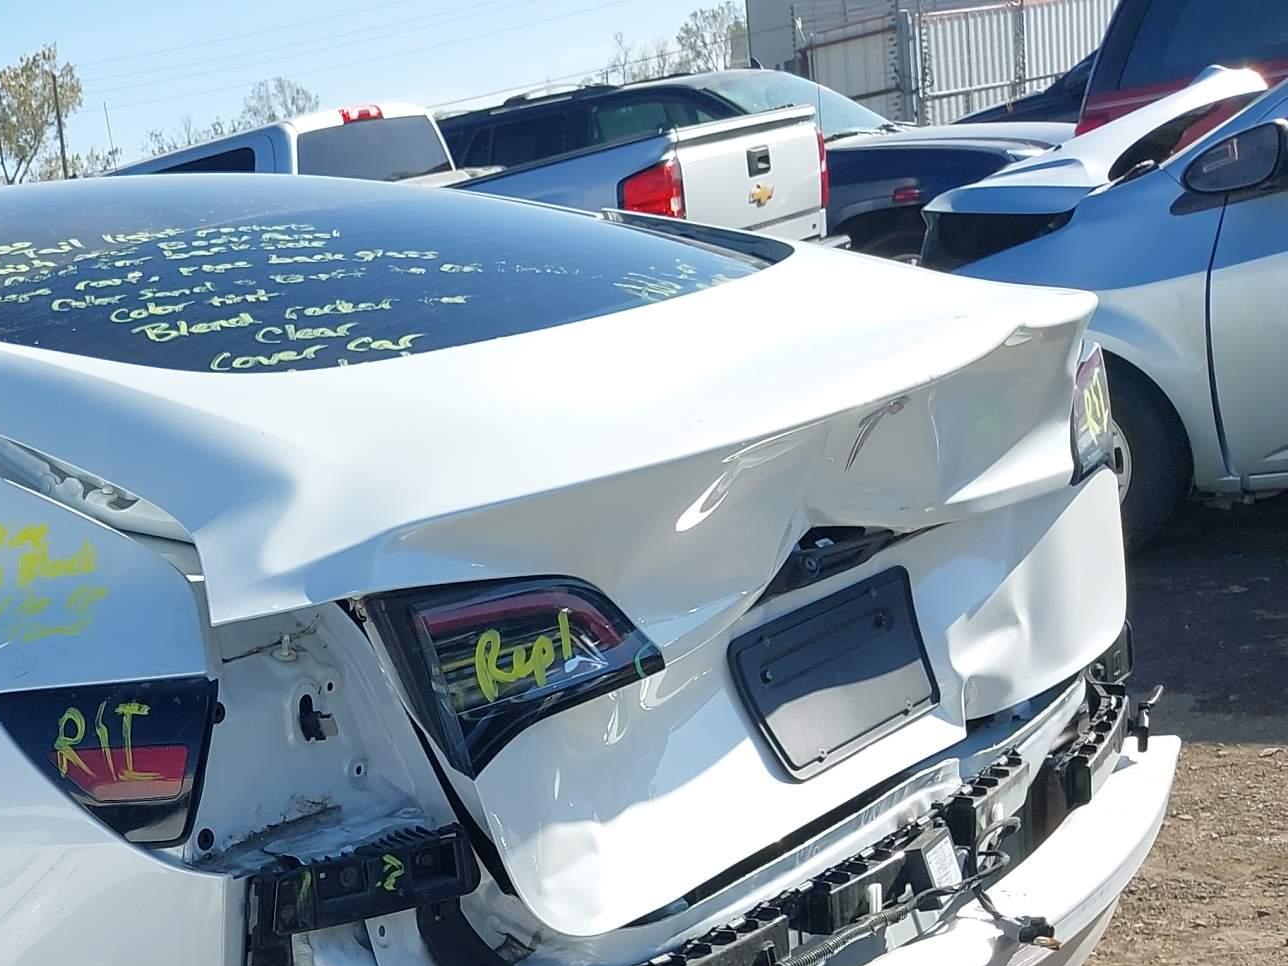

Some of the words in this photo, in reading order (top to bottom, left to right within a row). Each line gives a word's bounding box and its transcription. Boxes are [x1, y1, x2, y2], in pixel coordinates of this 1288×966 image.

[109, 300, 196, 323] Color
[130, 312, 263, 343] Blend
[255, 321, 361, 344] Clear
[210, 343, 330, 372] Cover
[346, 332, 430, 353] Car
